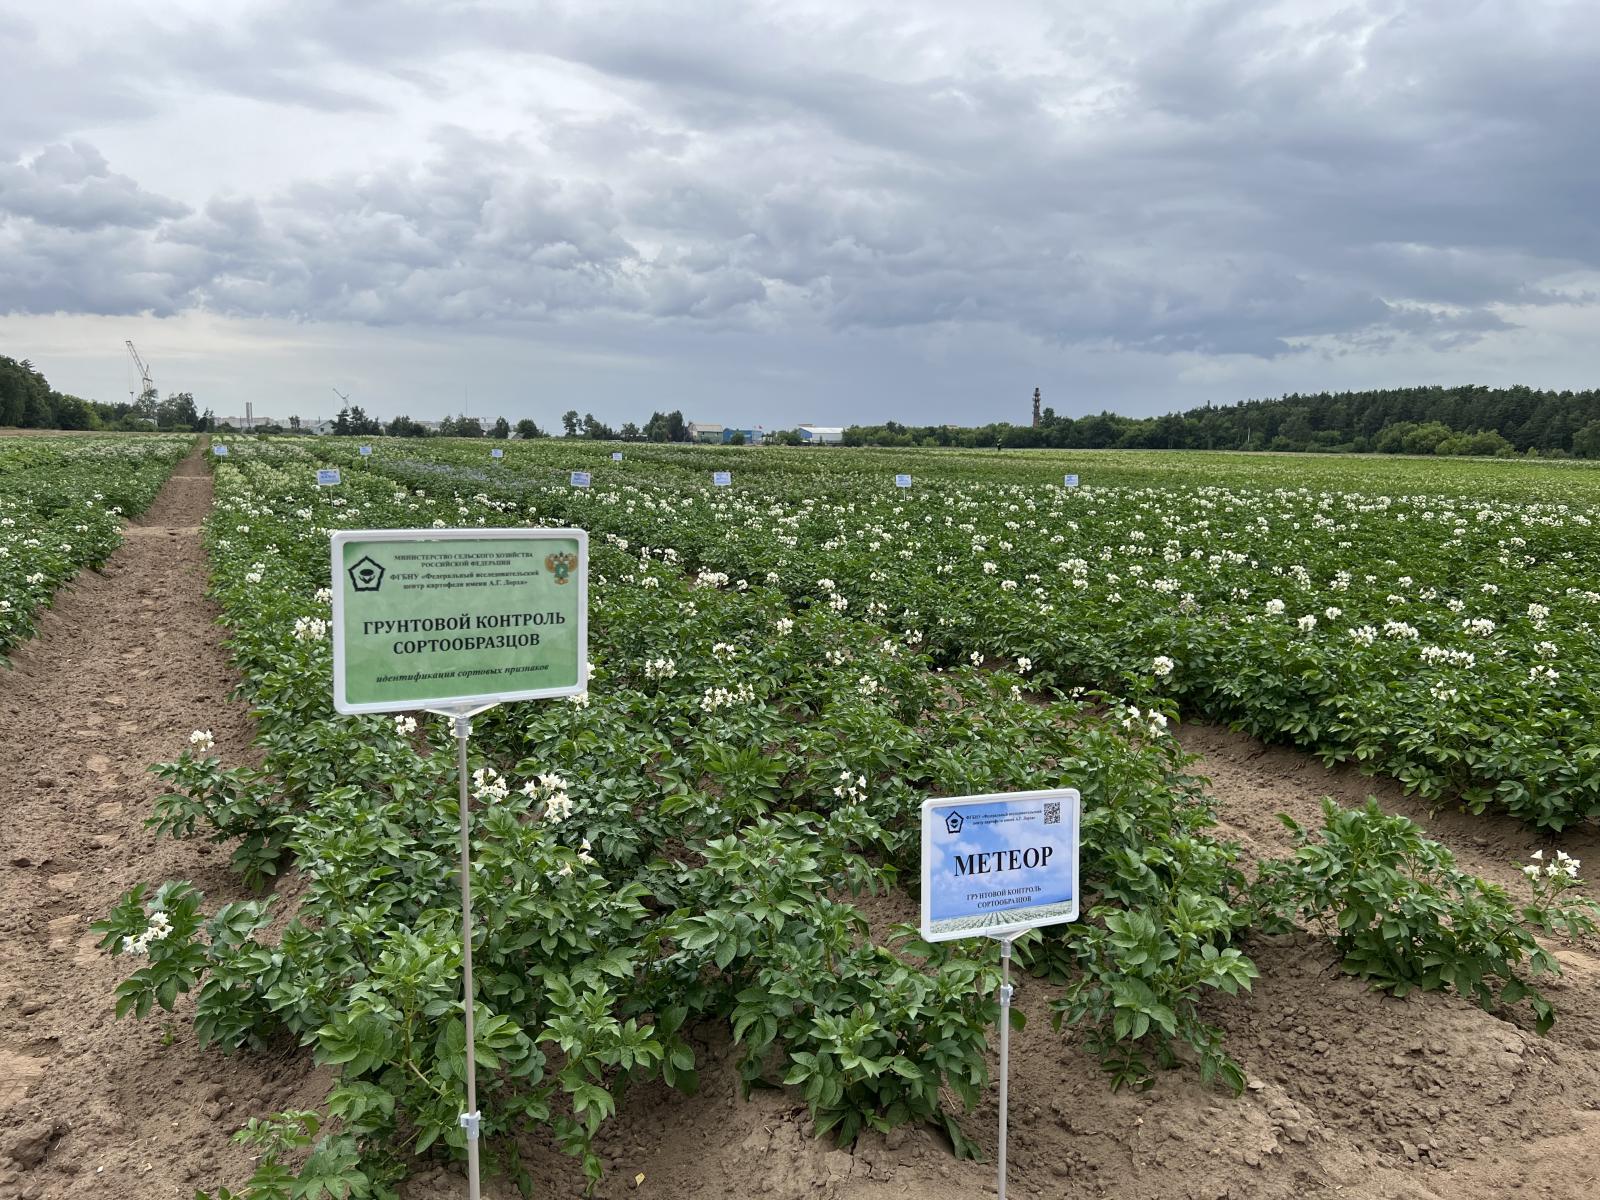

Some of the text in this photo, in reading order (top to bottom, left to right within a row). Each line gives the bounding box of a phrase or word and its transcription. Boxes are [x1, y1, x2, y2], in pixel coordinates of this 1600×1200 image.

[363, 612, 566, 635] ГРУНТОВОЙ КОНТРОЛЬ
[393, 633, 540, 655] СОРТООБРАЗЦОВ
[376, 664, 550, 683] идентификация сортовых признаков
[953, 846, 1053, 876] МЕТЕОР
[966, 885, 1042, 900] ГРУНТОВОЙ КОНТРОЛЬ
[977, 896, 1032, 908] СОРТООБРАЗЦОВ
